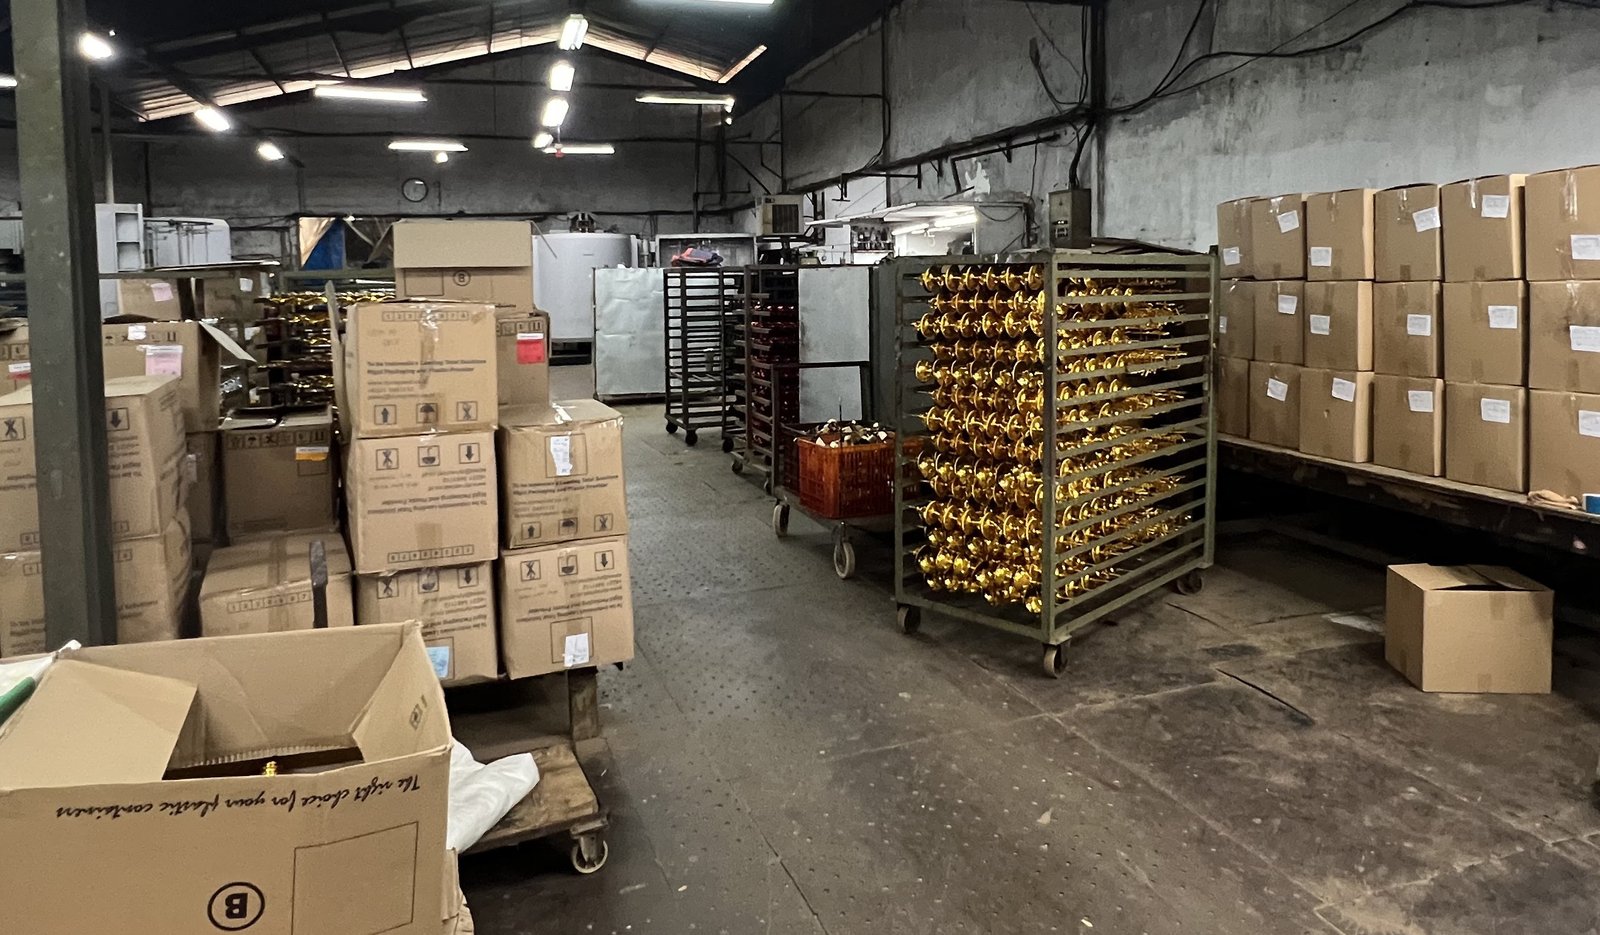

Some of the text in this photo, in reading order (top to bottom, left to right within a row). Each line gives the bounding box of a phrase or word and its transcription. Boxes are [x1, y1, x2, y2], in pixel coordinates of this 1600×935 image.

[55, 774, 421, 820] The right choice for your plastic containers
[225, 892, 249, 920] B
